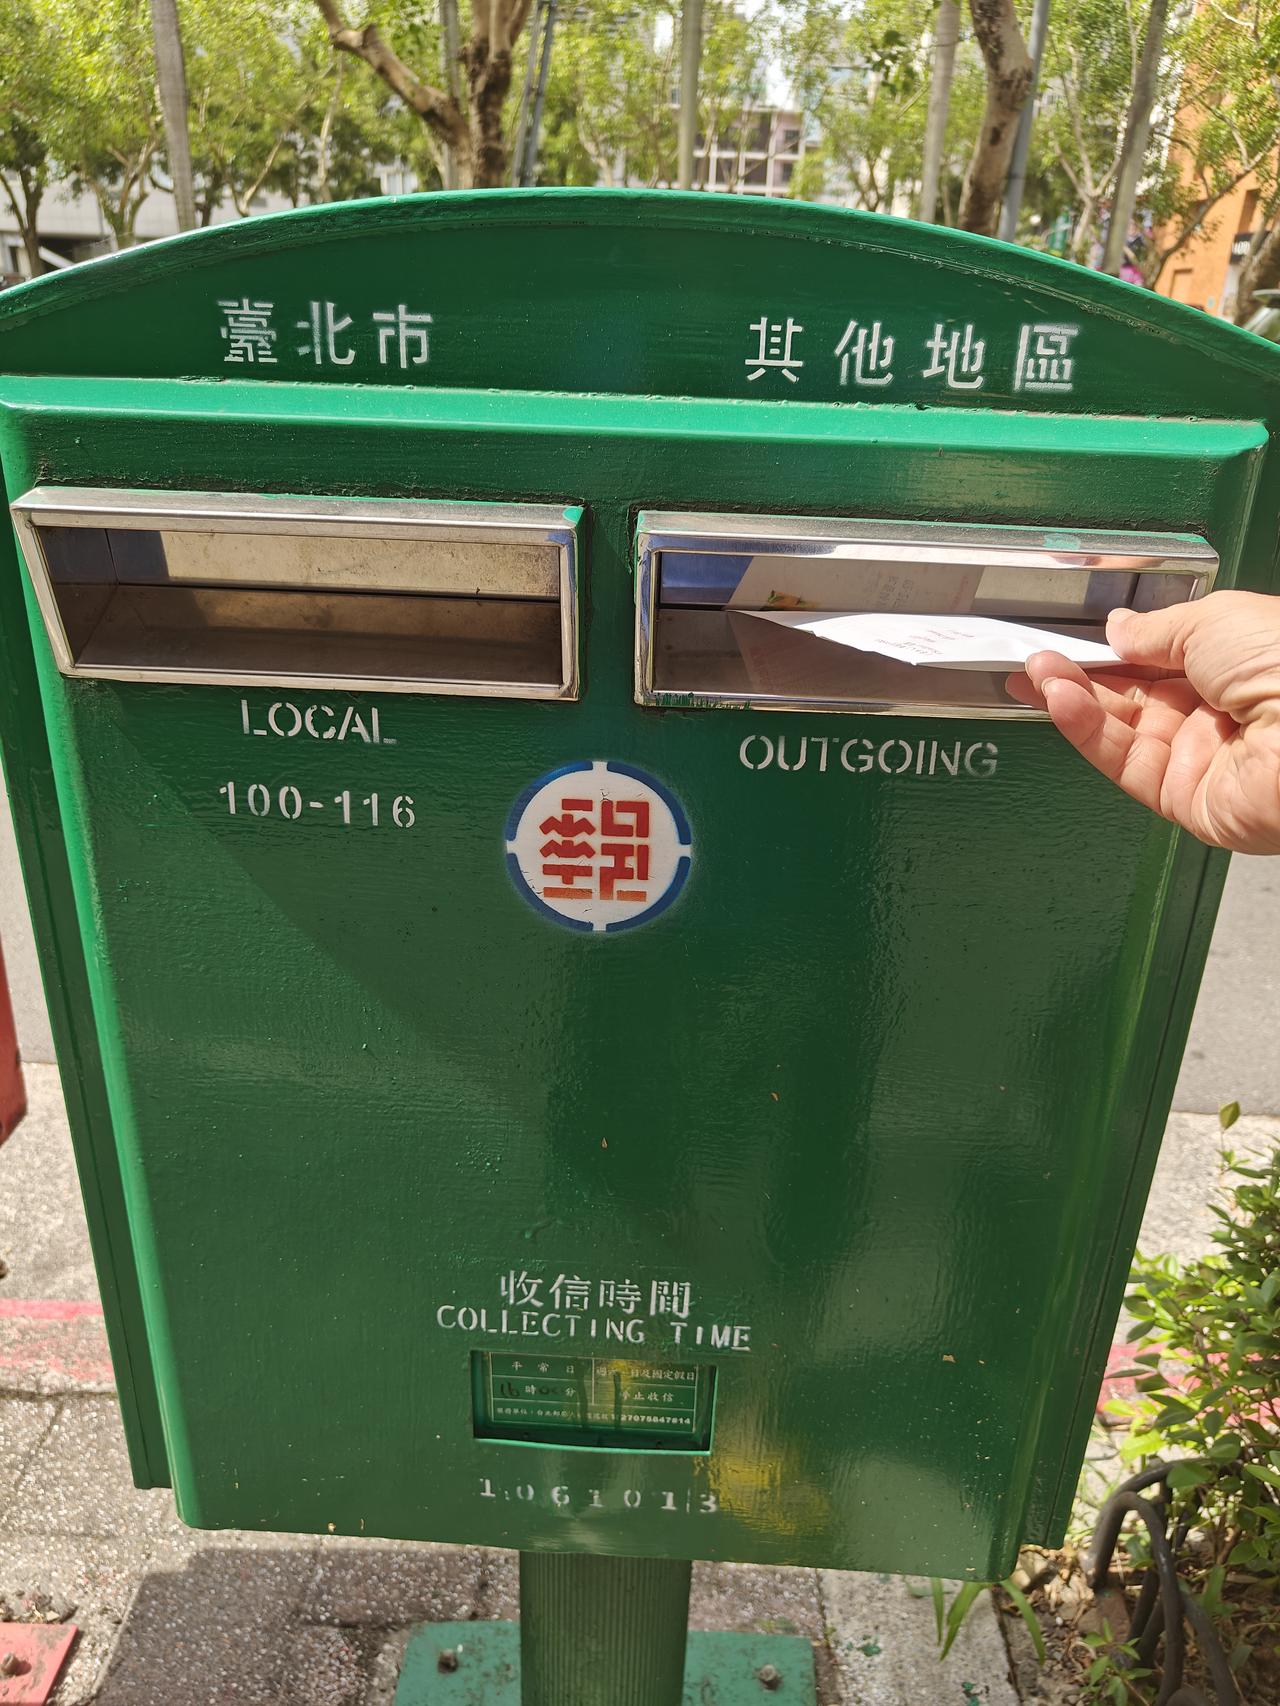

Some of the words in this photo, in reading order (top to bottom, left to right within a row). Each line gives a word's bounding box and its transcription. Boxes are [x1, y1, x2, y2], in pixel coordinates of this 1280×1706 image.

[217, 298, 433, 369] 臺北市
[745, 316, 1081, 392] 其他地區
[240, 699, 397, 744] LOCAL
[739, 734, 999, 777] OUTGOING
[219, 781, 416, 829] 100-116
[500, 1269, 693, 1319] 收信時間
[436, 1304, 646, 1344] COLLECTING
[669, 1321, 752, 1352] TIME
